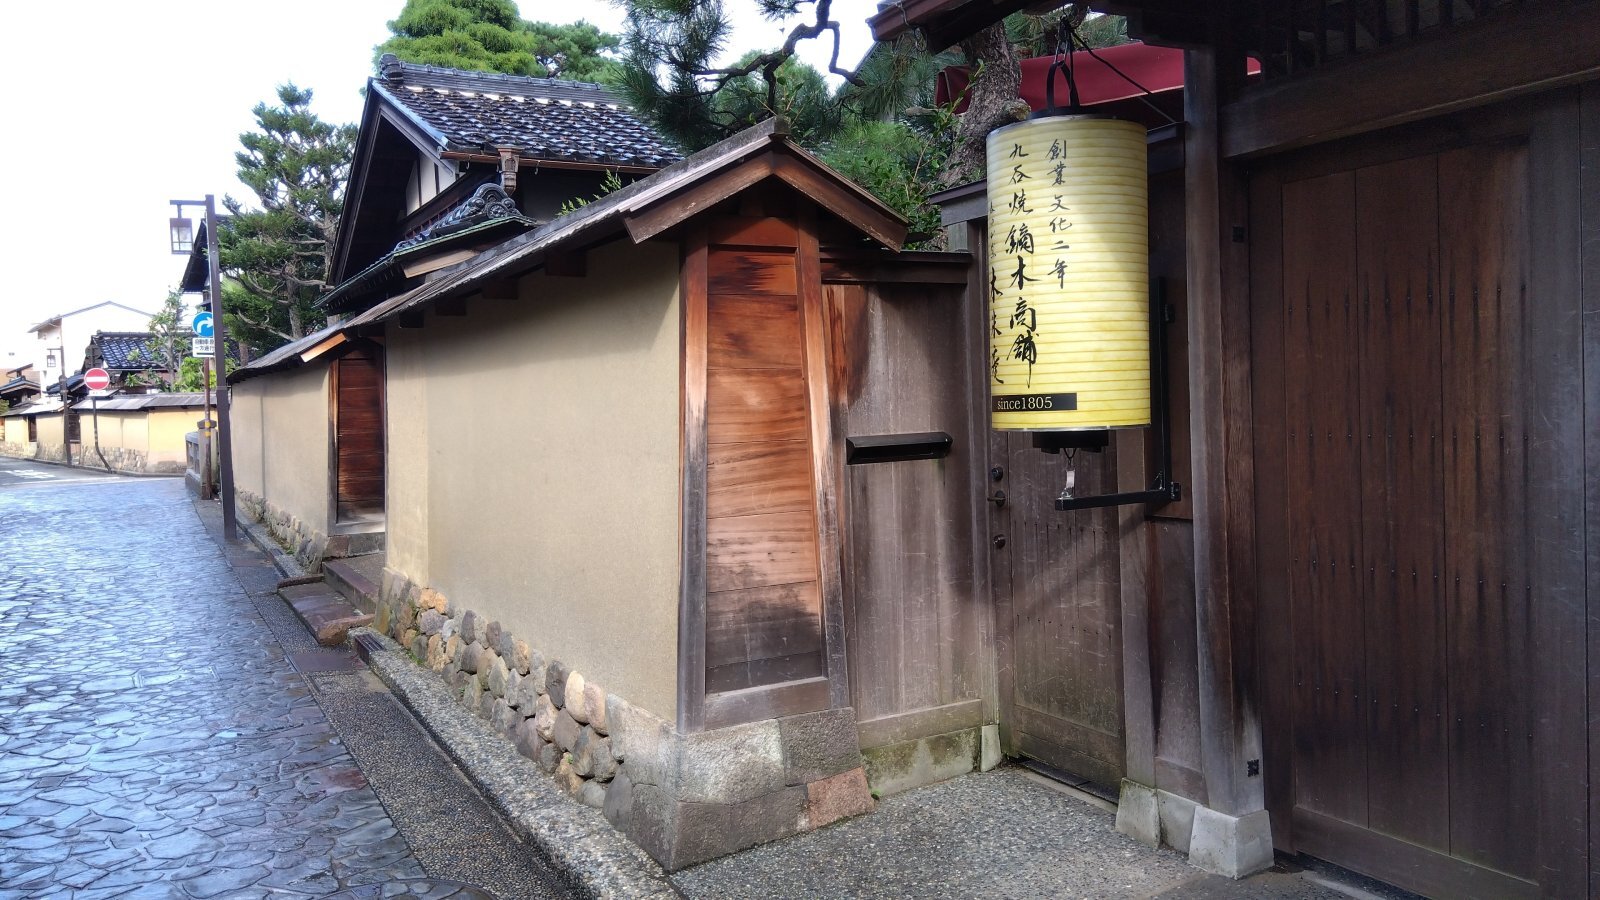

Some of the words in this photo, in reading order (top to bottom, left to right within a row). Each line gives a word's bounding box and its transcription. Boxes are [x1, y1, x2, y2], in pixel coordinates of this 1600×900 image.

[1045, 138, 1073, 289] 創業文化二年
[997, 396, 1053, 410] since1805
